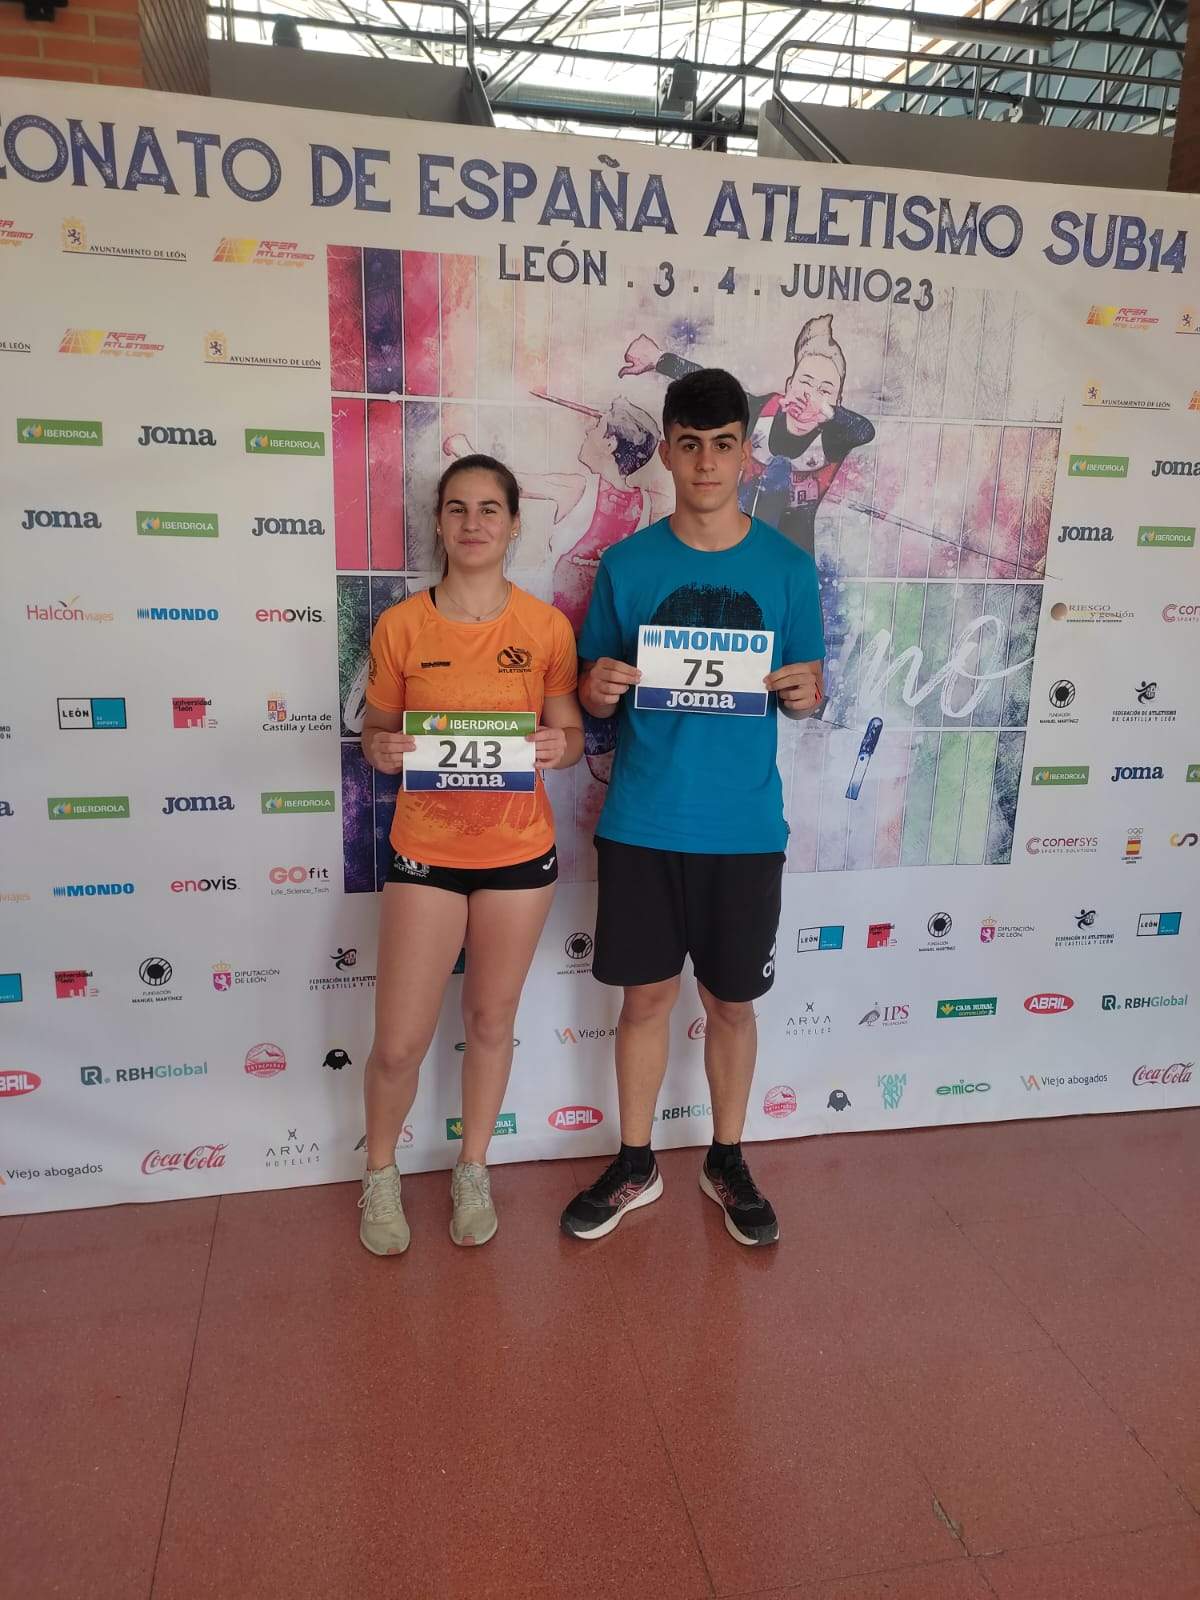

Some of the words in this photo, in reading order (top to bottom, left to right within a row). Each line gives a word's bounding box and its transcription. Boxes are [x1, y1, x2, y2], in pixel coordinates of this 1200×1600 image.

[0, 113, 282, 202] ONATO
[309, 143, 392, 213] DE
[417, 153, 678, 236] ESPAÑA
[703, 180, 1024, 258] ATLETISMO
[1042, 210, 1189, 274] SUB14
[89, 245, 151, 257] AYUNTAMIENTO
[154, 250, 164, 258] DE
[166, 249, 187, 259] LEÓN
[499, 240, 608, 286] LEÓN
[653, 261, 675, 298] 3
[718, 265, 736, 295] 4
[780, 263, 934, 312] JUNIO23
[9, 341, 32, 350] LEÓN
[230, 355, 288, 365] AYUNTAMIENTO
[301, 358, 321, 367] LEÓN
[1101, 399, 1146, 407] AYUNTAMIENTO
[43, 428, 98, 440] IBERDROLA
[269, 438, 321, 450] IBERDROLA
[1086, 463, 1125, 472] IBERDROLA
[161, 520, 214, 532] IBERDROLA
[1154, 533, 1192, 542] IBERDROLA
[150, 607, 220, 621] MONDO
[255, 606, 323, 623] enovis
[664, 629, 768, 654] MONDO
[683, 658, 725, 688] 75
[62, 707, 90, 718] LEÓN
[289, 713, 317, 723] Junta
[319, 713, 332, 722] de
[262, 722, 298, 732] Castilla
[299, 724, 306, 733] y
[308, 722, 332, 732] León
[450, 719, 518, 731] IBERDROLA
[438, 740, 503, 769] 243
[1050, 771, 1086, 780] IBERDROLA
[73, 803, 125, 814] IBERDROLA
[284, 797, 331, 808] IBERDROLA
[67, 883, 135, 897] MONDO
[170, 875, 237, 893] enovis
[800, 934, 819, 944] LEÓN
[234, 968, 281, 978] DIPUTACIÓN
[234, 977, 245, 985] DE
[246, 975, 267, 985] LEÓN
[1028, 997, 1068, 1010] ABRIL
[1124, 994, 1189, 1009] RBHGlobal
[883, 1004, 910, 1021] IPS
[579, 1028, 605, 1040] Viejo
[116, 1062, 208, 1082] RBHGlobal
[1132, 1062, 1195, 1087] Coca-Cola
[1041, 1076, 1065, 1088] Viejo
[1067, 1073, 1108, 1087] abogados
[936, 1079, 991, 1096] emico
[555, 1110, 599, 1126] ABRIL
[266, 1142, 320, 1157] ARVA
[141, 1143, 230, 1176] Coca-Cola
[7, 1168, 40, 1180] Viejo
[44, 1163, 104, 1178] abogados
